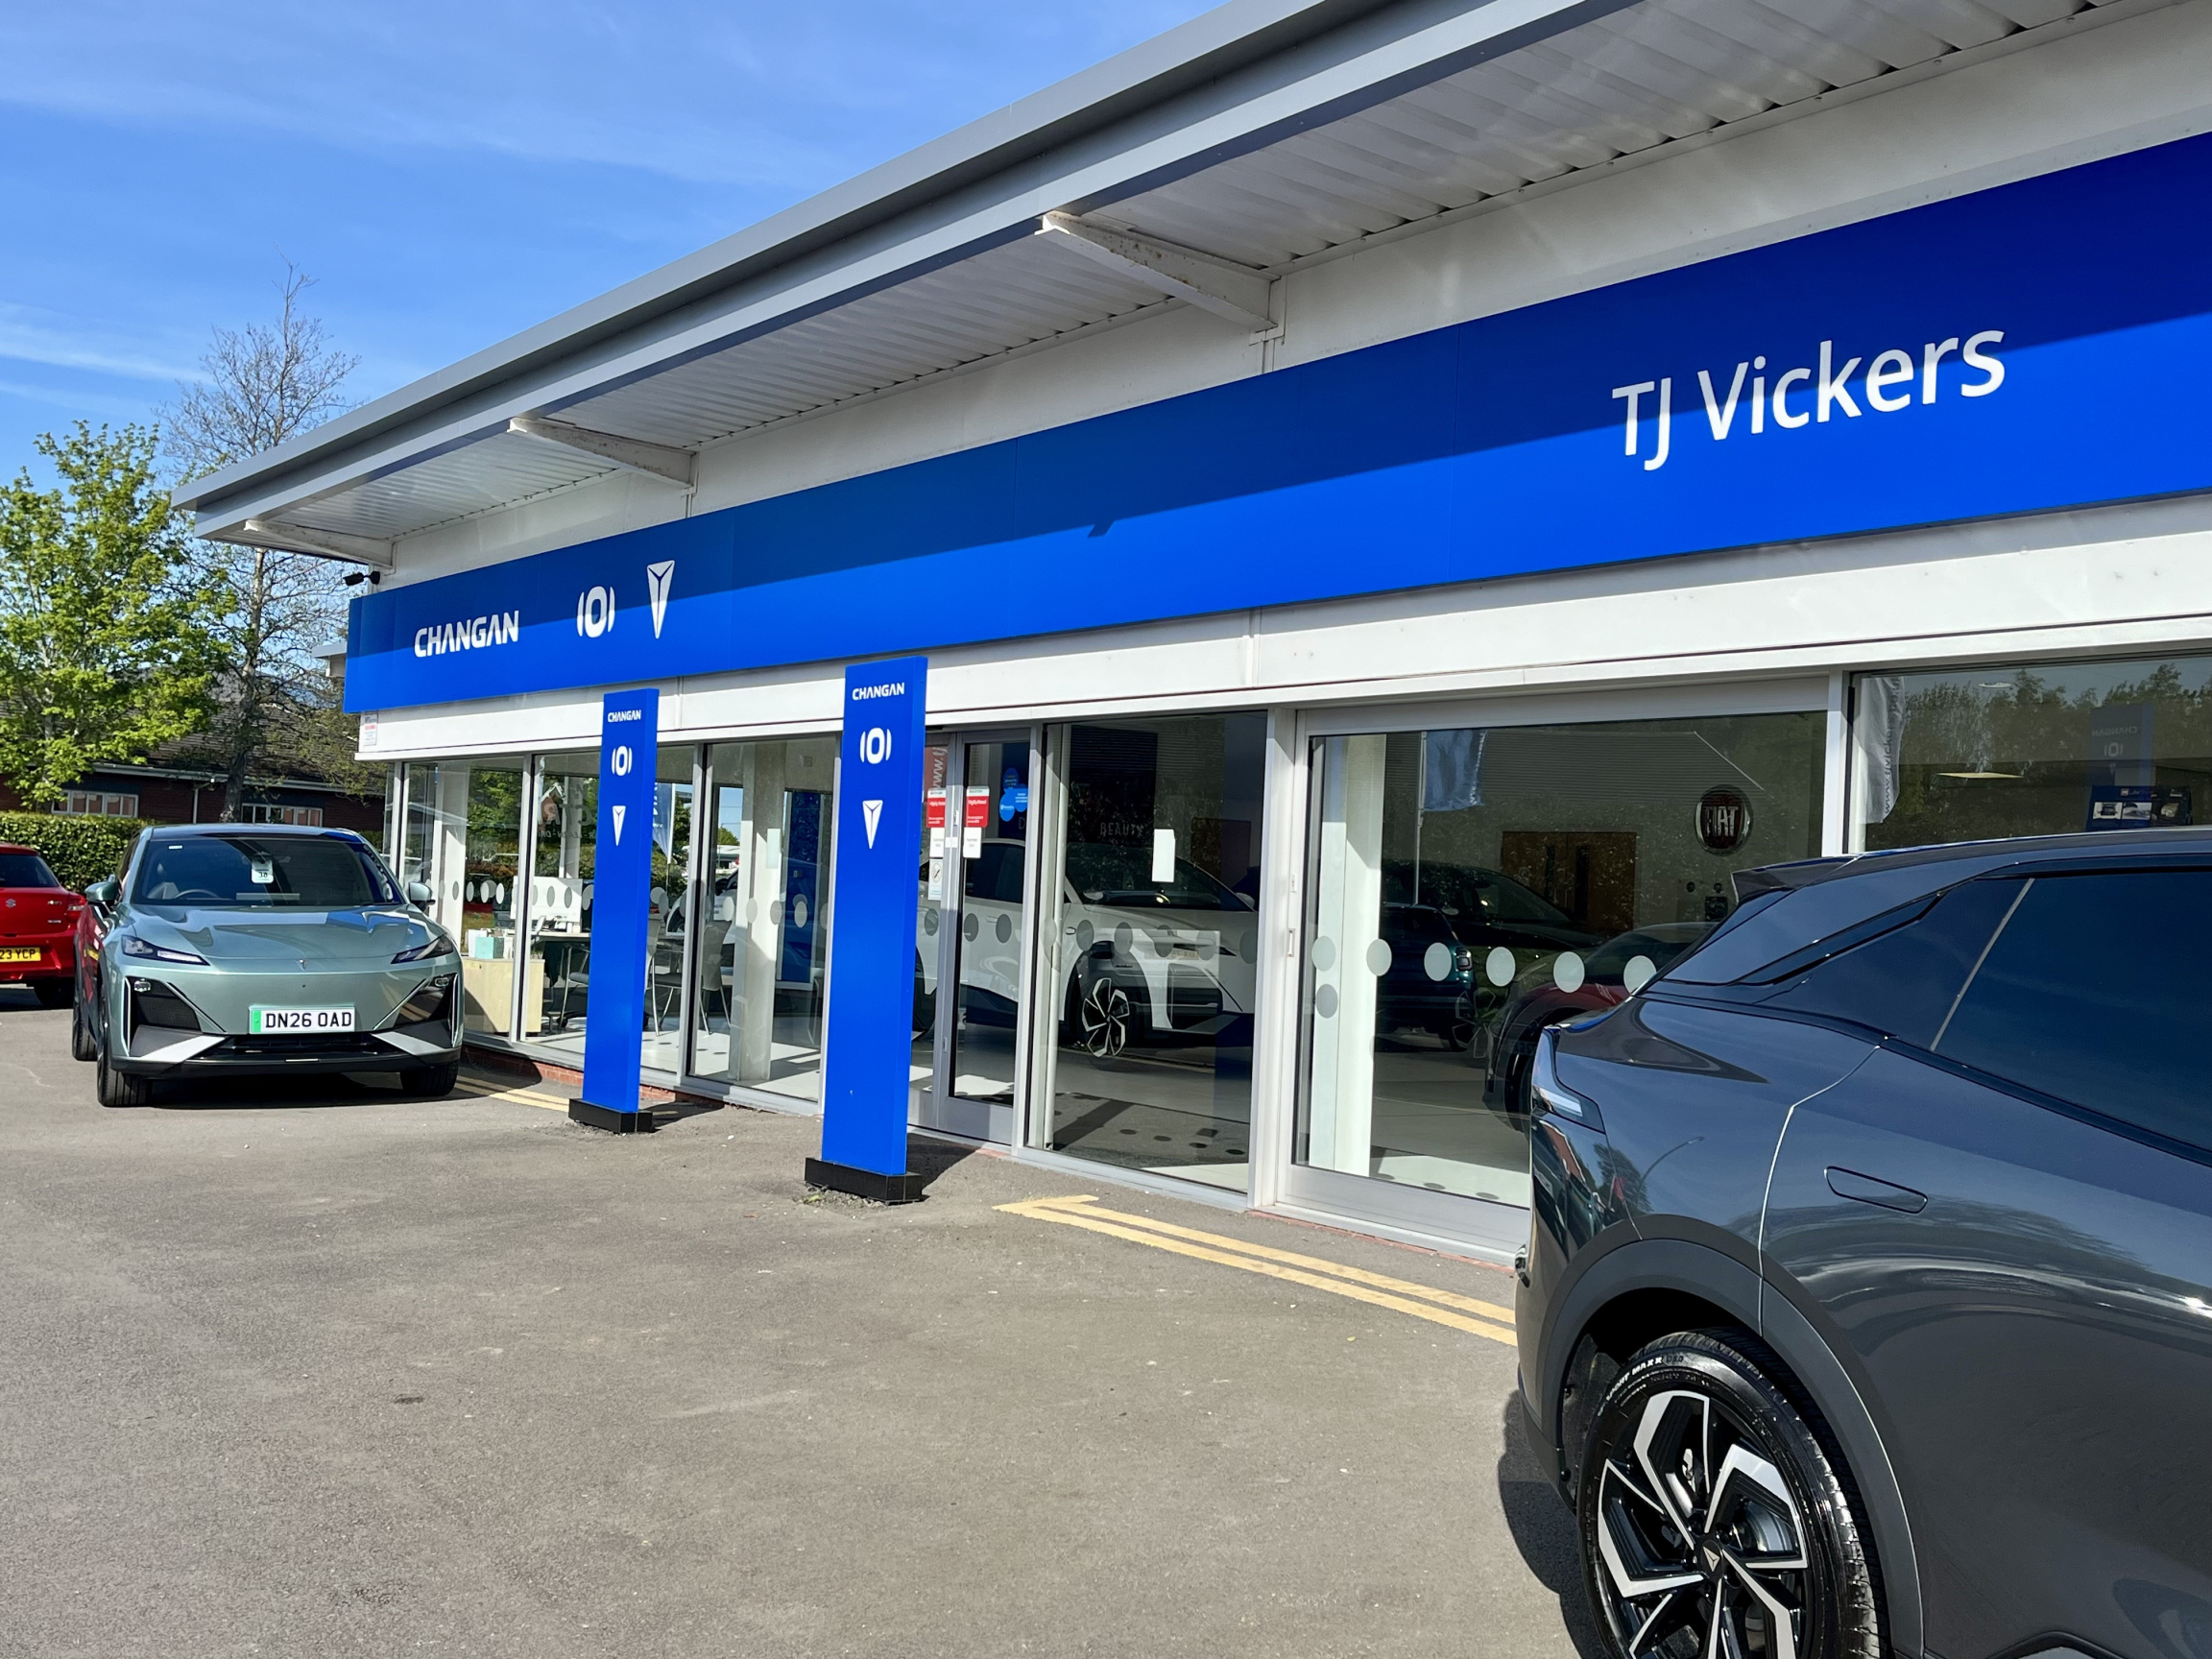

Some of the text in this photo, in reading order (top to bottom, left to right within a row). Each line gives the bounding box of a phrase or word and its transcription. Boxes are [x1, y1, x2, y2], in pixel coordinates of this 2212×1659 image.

[1612, 330, 2006, 470] TJ Vickers
[414, 610, 519, 658] CHANGAN
[852, 682, 905, 701] CHANGAN
[608, 709, 642, 723] CHANGAN
[1703, 805, 1739, 836] FIAT
[15, 948, 36, 959] YCP
[265, 1012, 352, 1028] DN26 OAD
[1631, 1356, 1663, 1376] MAXX
